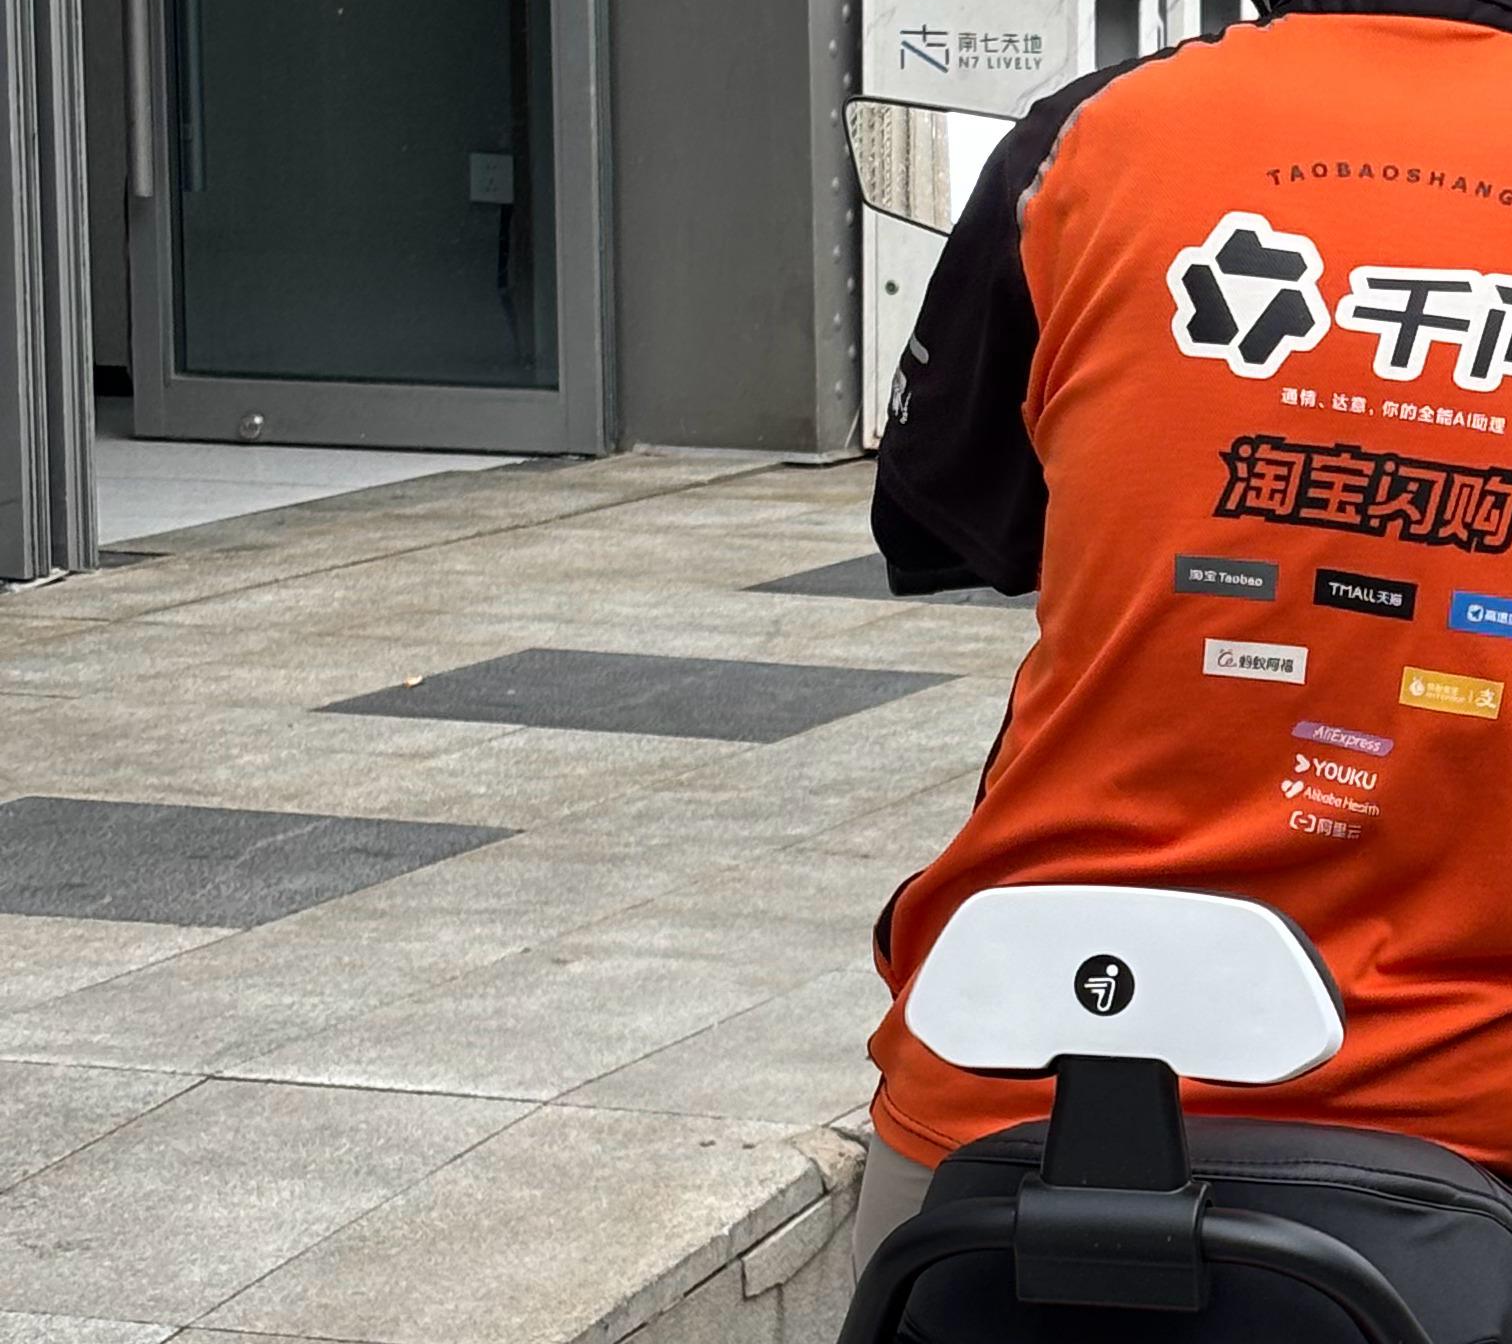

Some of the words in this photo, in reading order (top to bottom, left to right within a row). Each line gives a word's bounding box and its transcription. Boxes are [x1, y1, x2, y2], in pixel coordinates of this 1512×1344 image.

[957, 32, 1043, 54] 南七天地
[958, 56, 980, 70] N7
[987, 56, 1043, 71] LIVELY
[1313, 725, 1382, 752] AliExpress
[1312, 758, 1378, 790] YOUKU
[1316, 817, 1362, 840] 阿里云
